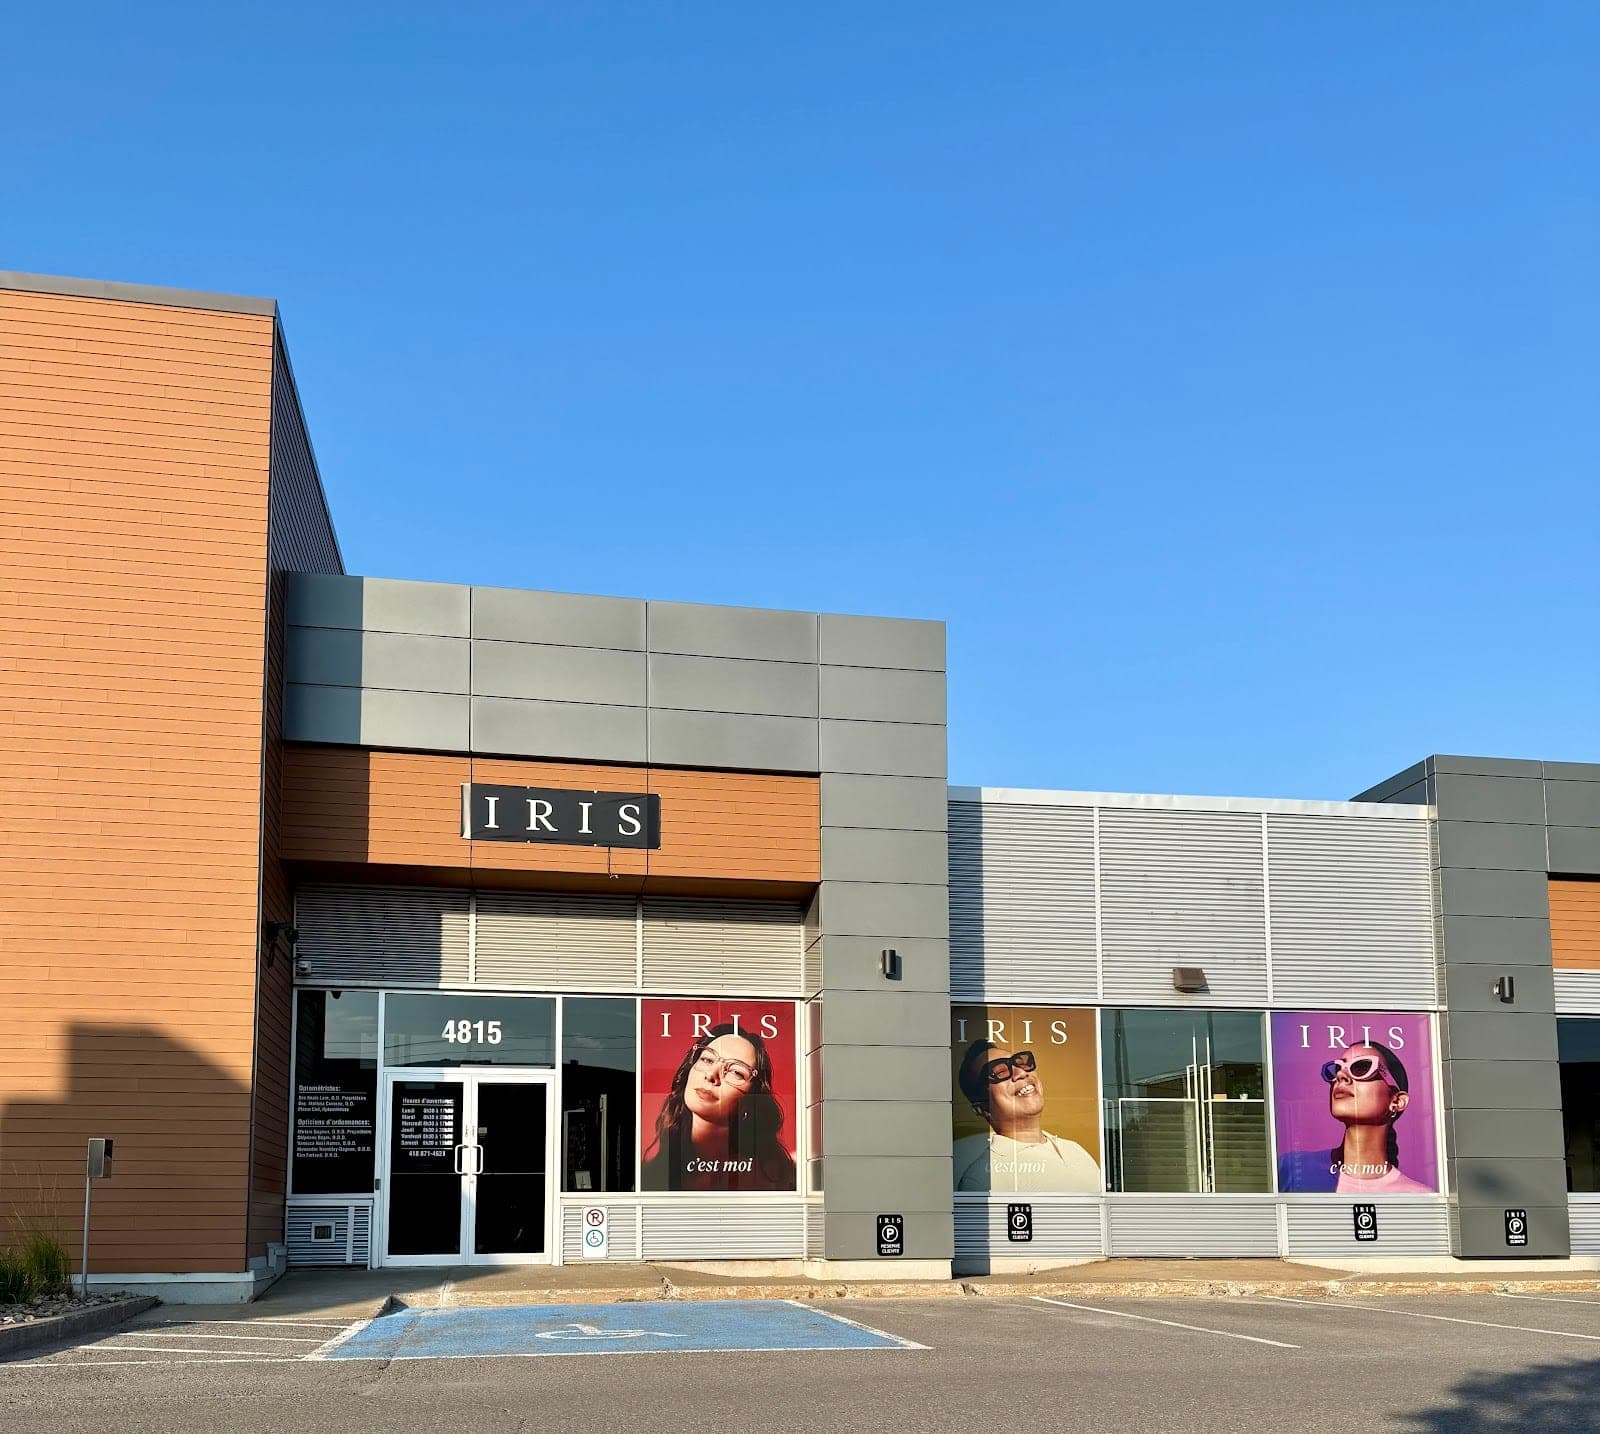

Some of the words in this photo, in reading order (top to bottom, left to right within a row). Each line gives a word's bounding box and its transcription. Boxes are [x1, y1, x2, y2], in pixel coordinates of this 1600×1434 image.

[484, 796, 641, 836] IRIS
[441, 1019, 502, 1045] 4815
[660, 1012, 778, 1038] IRIS
[957, 1019, 1068, 1044] IRIS
[1300, 1024, 1405, 1049] IRIS
[687, 1157, 719, 1172] c'est
[723, 1157, 752, 1172] moi
[1018, 1159, 1046, 1174] moi
[1330, 1161, 1359, 1175] c'est
[1362, 1161, 1389, 1175] moi
